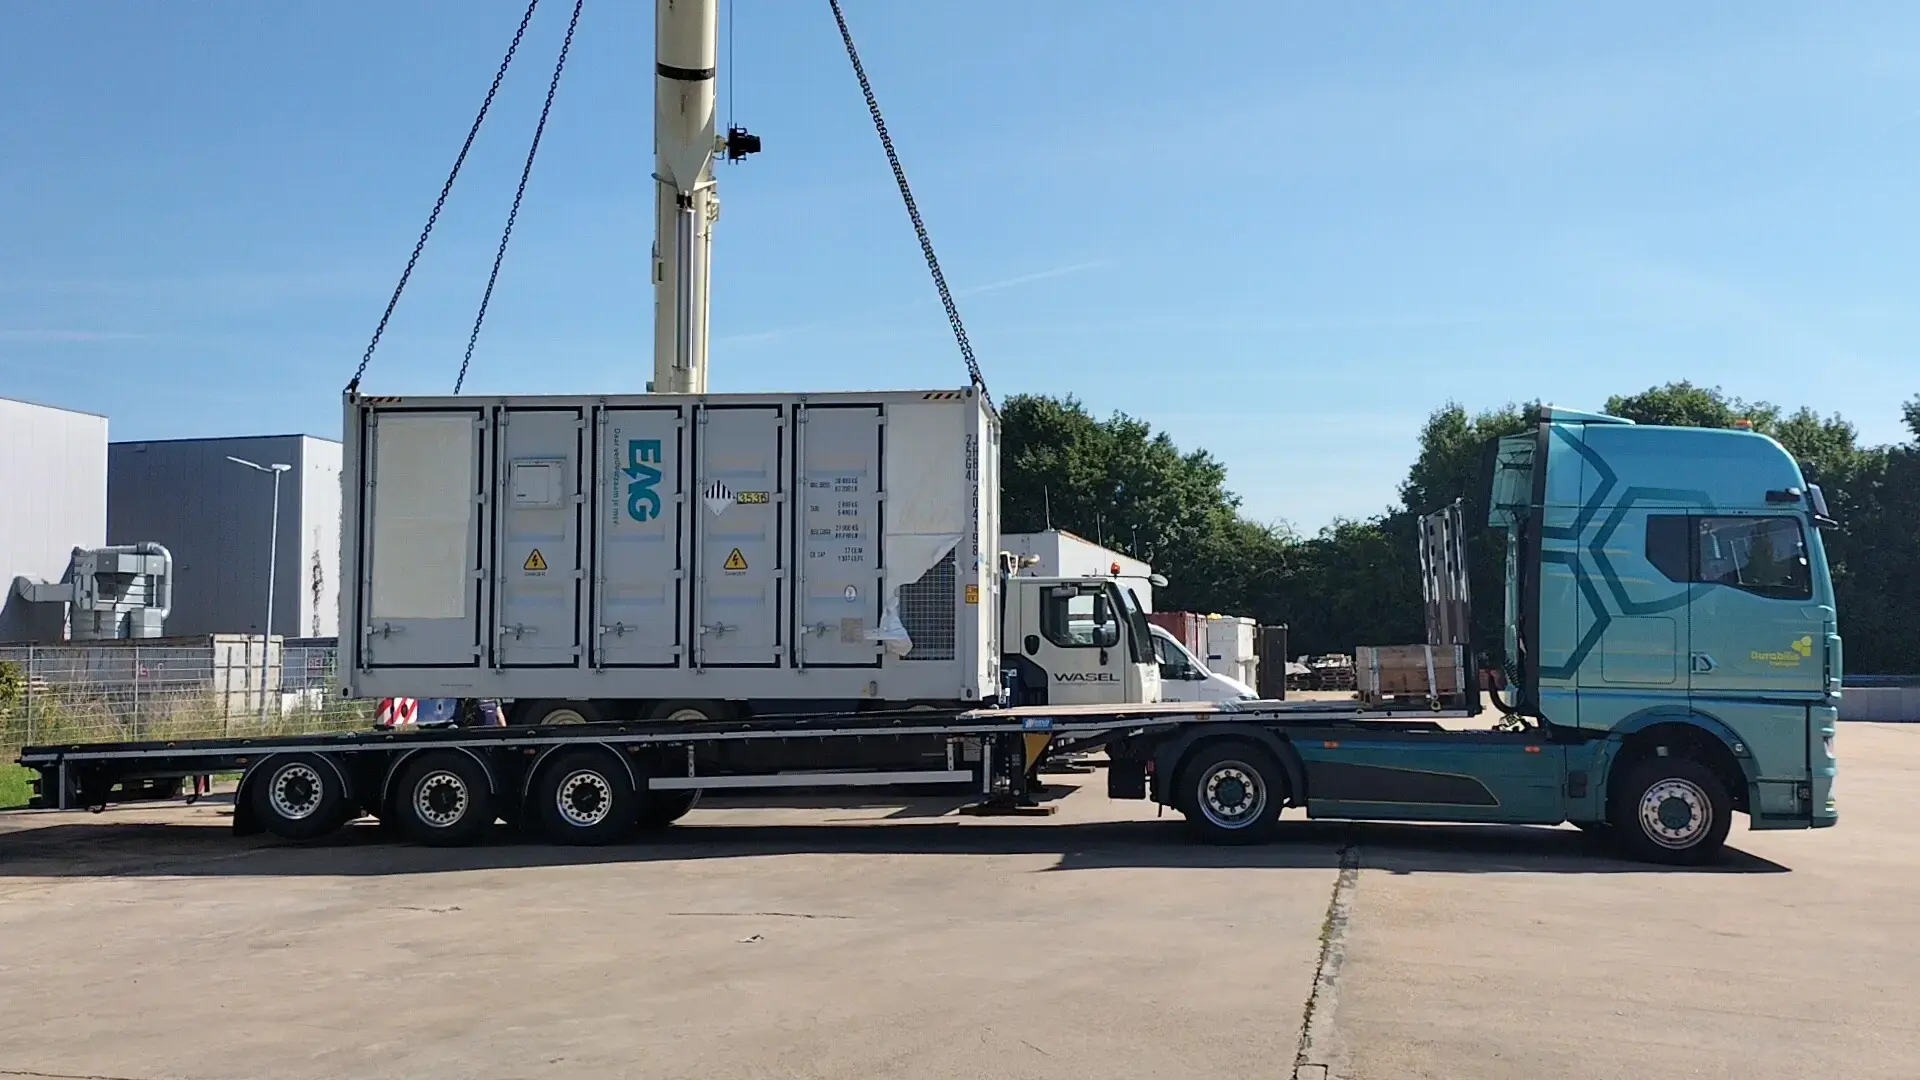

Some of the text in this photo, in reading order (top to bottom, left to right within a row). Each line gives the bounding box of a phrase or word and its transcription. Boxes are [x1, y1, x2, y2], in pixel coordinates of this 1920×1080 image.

[622, 439, 662, 522] EAG
[739, 493, 767, 504] 3536
[1053, 672, 1121, 682] WASEL
